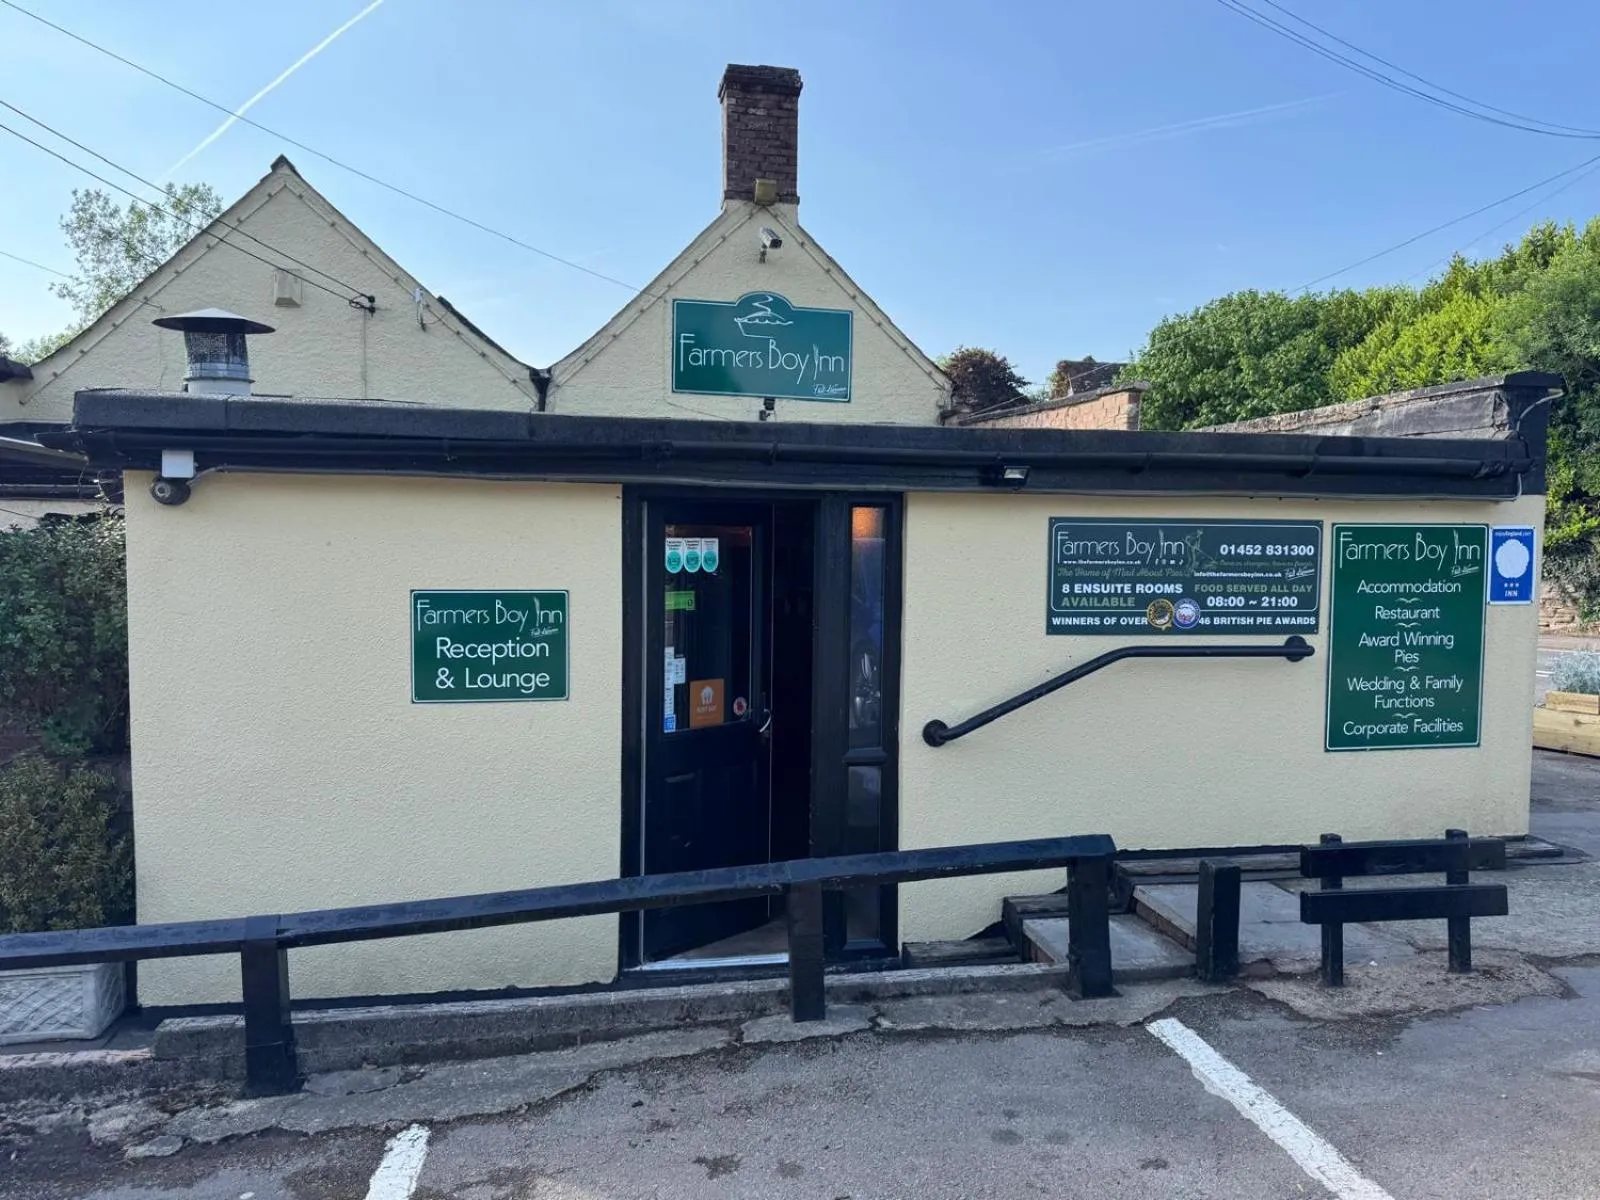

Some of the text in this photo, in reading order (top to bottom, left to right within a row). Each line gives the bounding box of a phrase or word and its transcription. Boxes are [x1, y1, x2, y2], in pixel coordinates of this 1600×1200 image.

[679, 333, 844, 385] Farmers Boy Inn
[1057, 529, 1185, 565] Farmers Boy Inn
[1220, 544, 1315, 556] 01452 831300
[1339, 529, 1481, 571] Farmers Boy Inn
[1061, 583, 1184, 594] 8 ENSUITE ROOMS
[1194, 584, 1313, 593] FOOD SERVED ALL DAY
[1356, 578, 1461, 594] Accommodation
[1504, 589, 1518, 597] INN
[1061, 596, 1136, 607] AVAILABLE
[1206, 596, 1245, 607] 08:00
[1260, 596, 1298, 607] 21:00
[416, 596, 563, 633] Farmers Boy Inn
[1375, 605, 1440, 620] Restaurant
[1051, 617, 1101, 625] WINNERS
[1103, 617, 1117, 625] OF
[1119, 617, 1149, 625] OVER
[1213, 617, 1254, 625] BRITISH
[1256, 617, 1272, 625] PIE
[1274, 617, 1317, 625] AWARDS
[1358, 631, 1455, 650] Award Winning
[436, 636, 549, 666] Reception
[1394, 649, 1420, 664] Pies
[435, 667, 550, 694] & Lounge
[1346, 674, 1464, 694] Wedding & Family
[1374, 694, 1436, 709] Functions
[1343, 718, 1464, 740] Corporate Facilities
